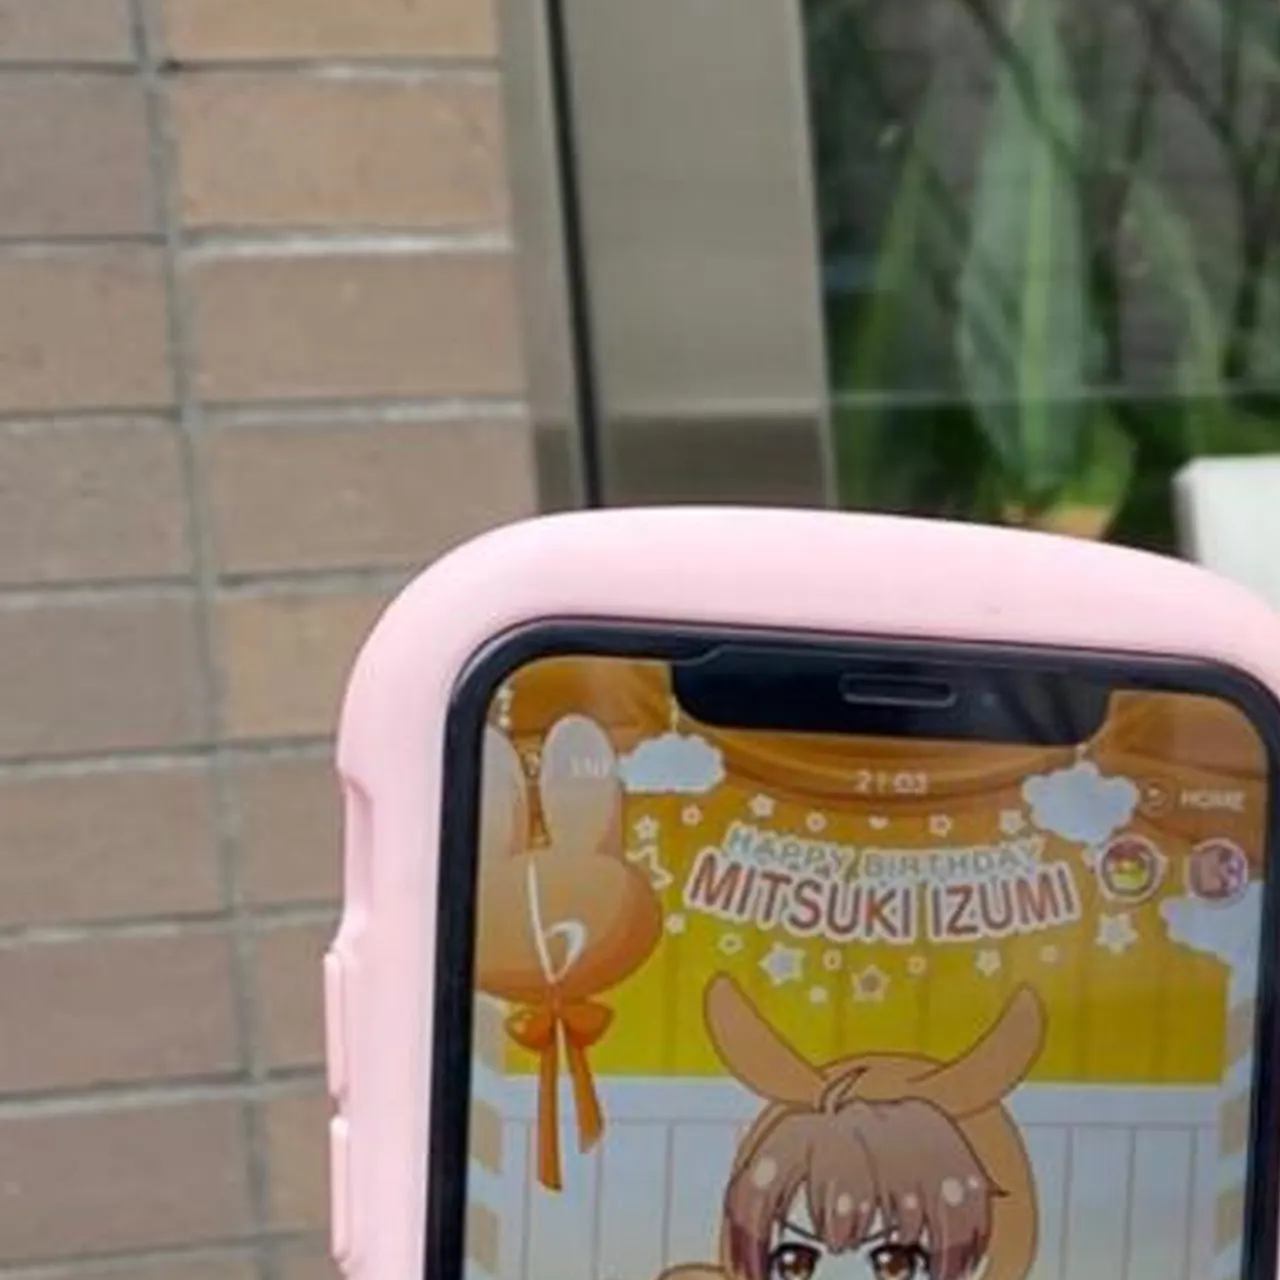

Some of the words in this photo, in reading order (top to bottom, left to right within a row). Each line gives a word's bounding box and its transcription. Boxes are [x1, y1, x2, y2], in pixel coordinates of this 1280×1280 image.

[1181, 790, 1245, 810] HOME
[864, 840, 1041, 880] BIRTHDAY
[688, 852, 912, 940] MITSUKI
[930, 868, 1076, 938] IZUMI
